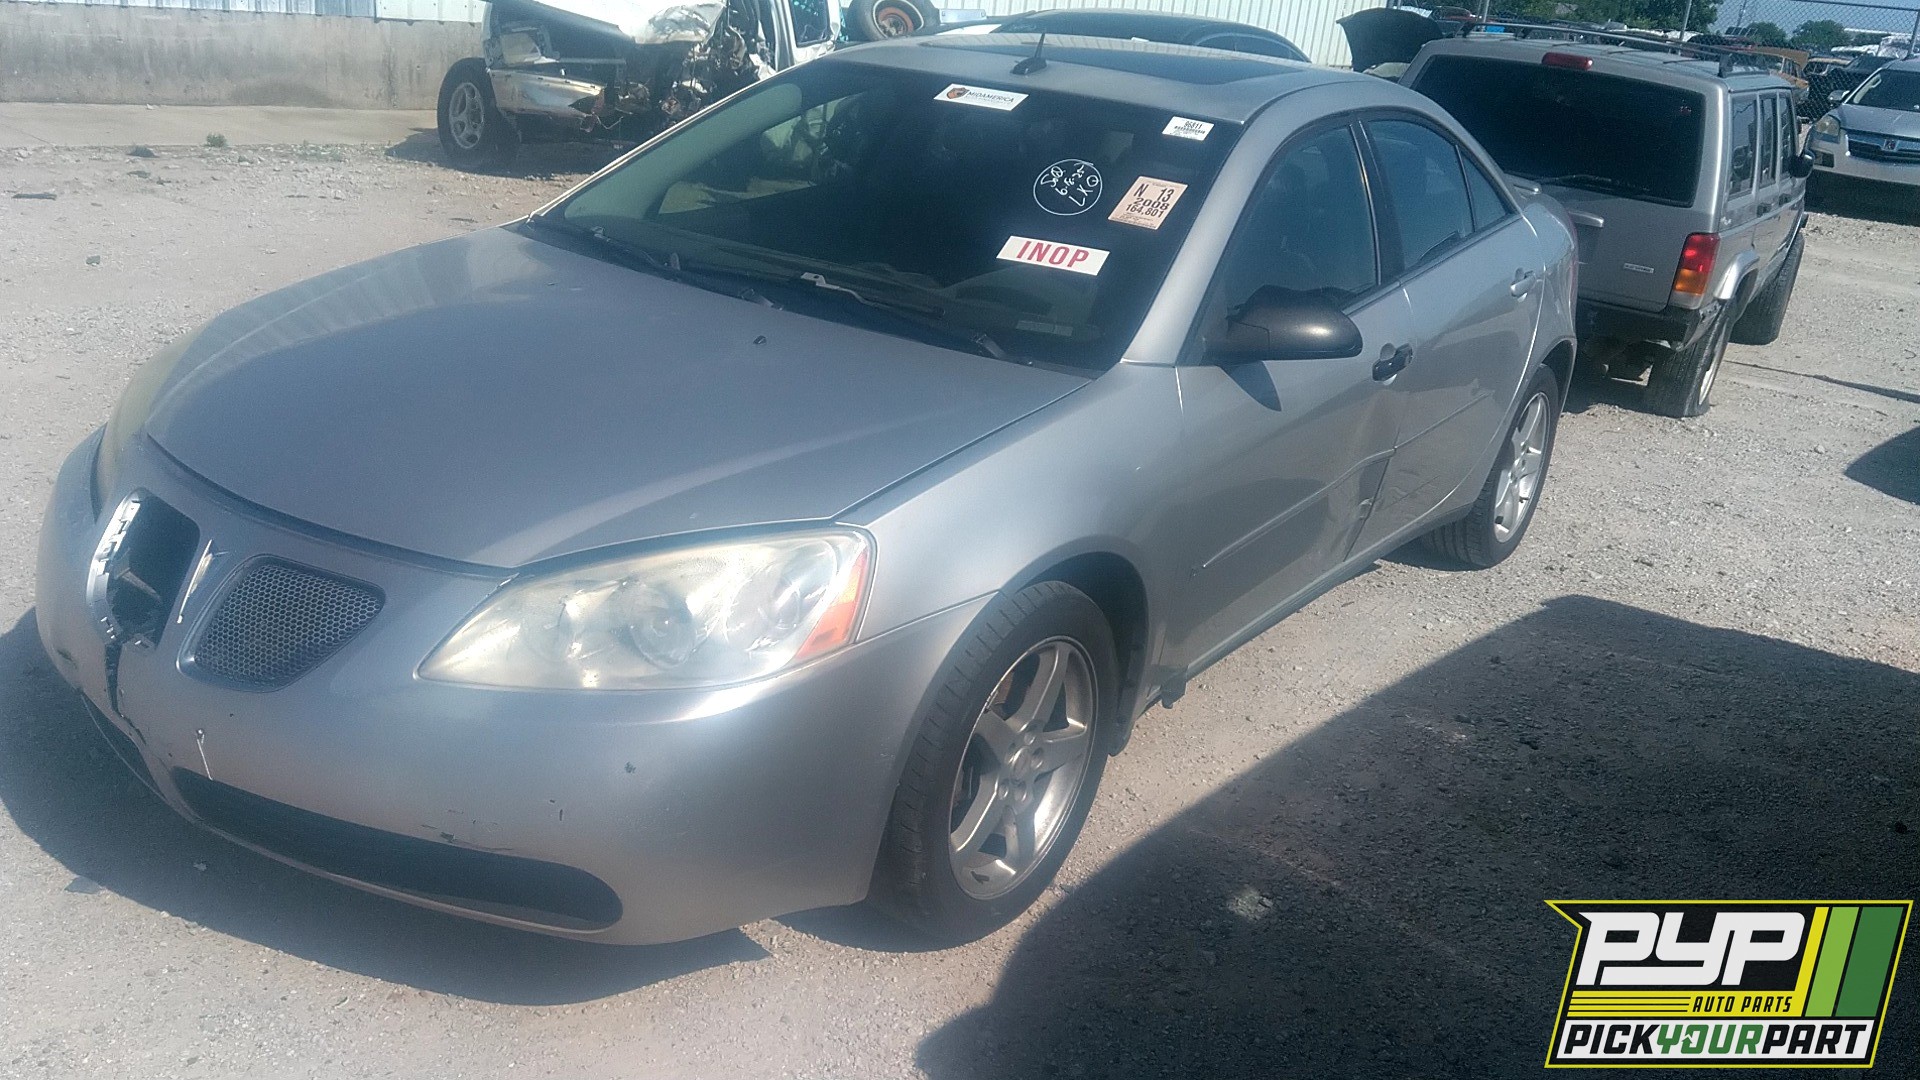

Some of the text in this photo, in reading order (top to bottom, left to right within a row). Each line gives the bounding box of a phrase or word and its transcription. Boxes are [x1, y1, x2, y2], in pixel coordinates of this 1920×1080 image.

[968, 91, 1014, 102] MIDAMERICA
[1133, 183, 1149, 197] N
[1157, 188, 1175, 202] 13
[1125, 204, 1165, 218] 164,801
[1133, 197, 1170, 211] 2008
[1016, 240, 1089, 267] INOP
